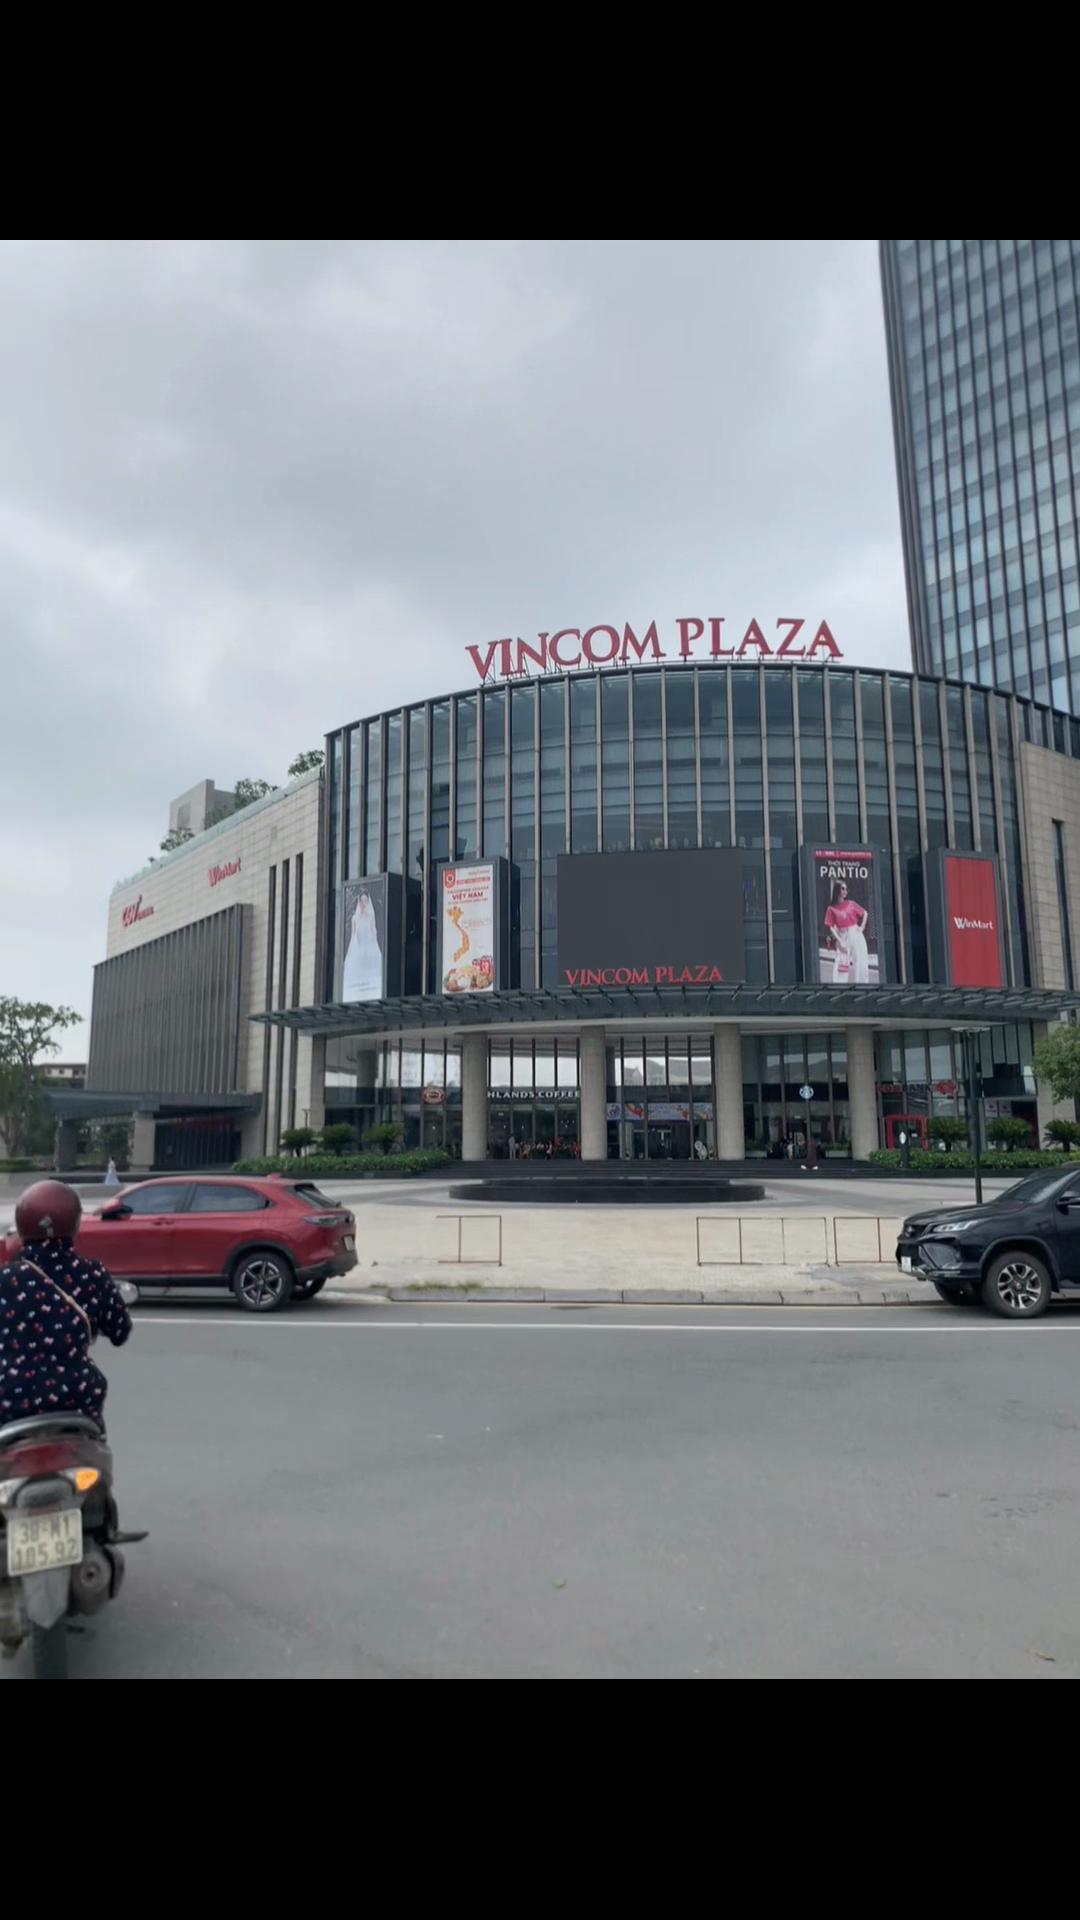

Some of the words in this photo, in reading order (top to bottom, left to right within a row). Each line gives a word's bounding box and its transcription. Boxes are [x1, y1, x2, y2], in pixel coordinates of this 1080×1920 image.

[465, 620, 666, 679] VINCOM
[676, 617, 844, 658] PLAZA
[820, 866, 869, 879] PANTIO
[953, 916, 994, 930] WinMart
[565, 967, 649, 985] VINCOM
[655, 965, 724, 984] PLAZA
[487, 1091, 535, 1099] HLANDS
